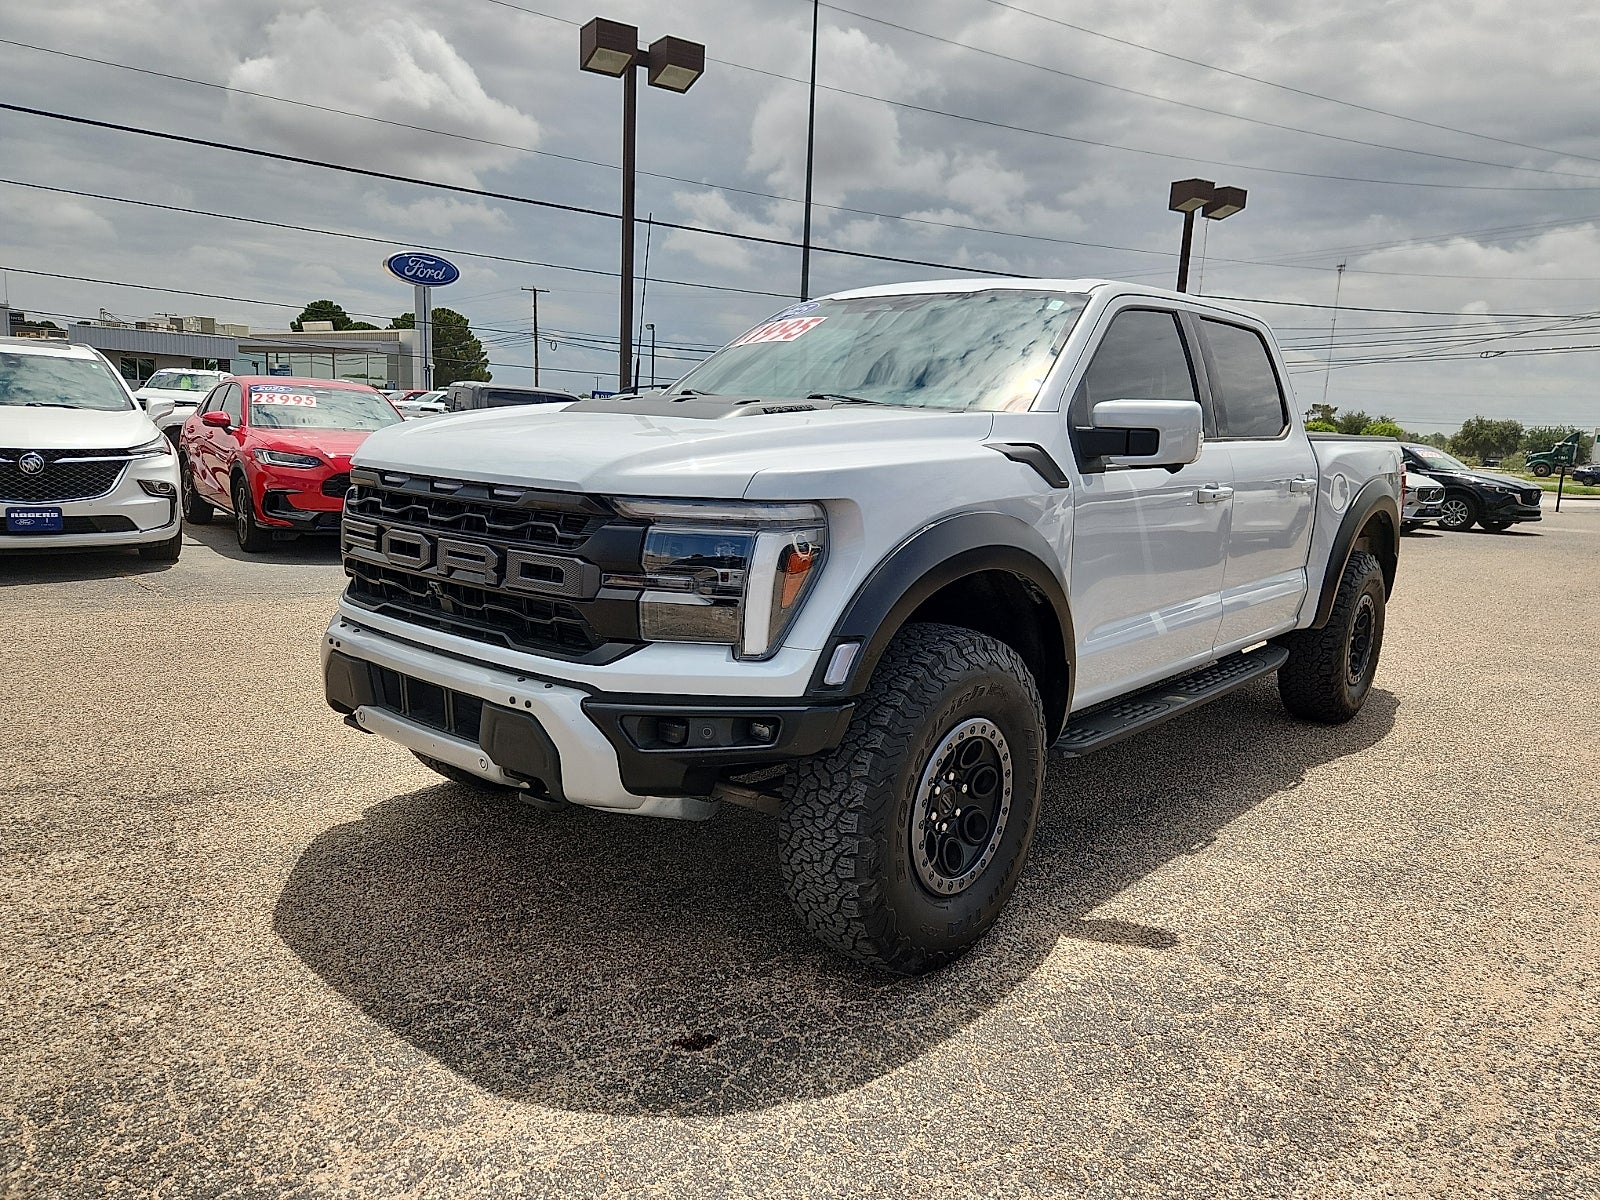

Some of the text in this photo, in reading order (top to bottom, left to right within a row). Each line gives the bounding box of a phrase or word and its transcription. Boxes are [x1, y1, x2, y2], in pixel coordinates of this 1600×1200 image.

[404, 257, 446, 280] Ford
[252, 393, 315, 406] 28995
[341, 518, 600, 599] FORD
